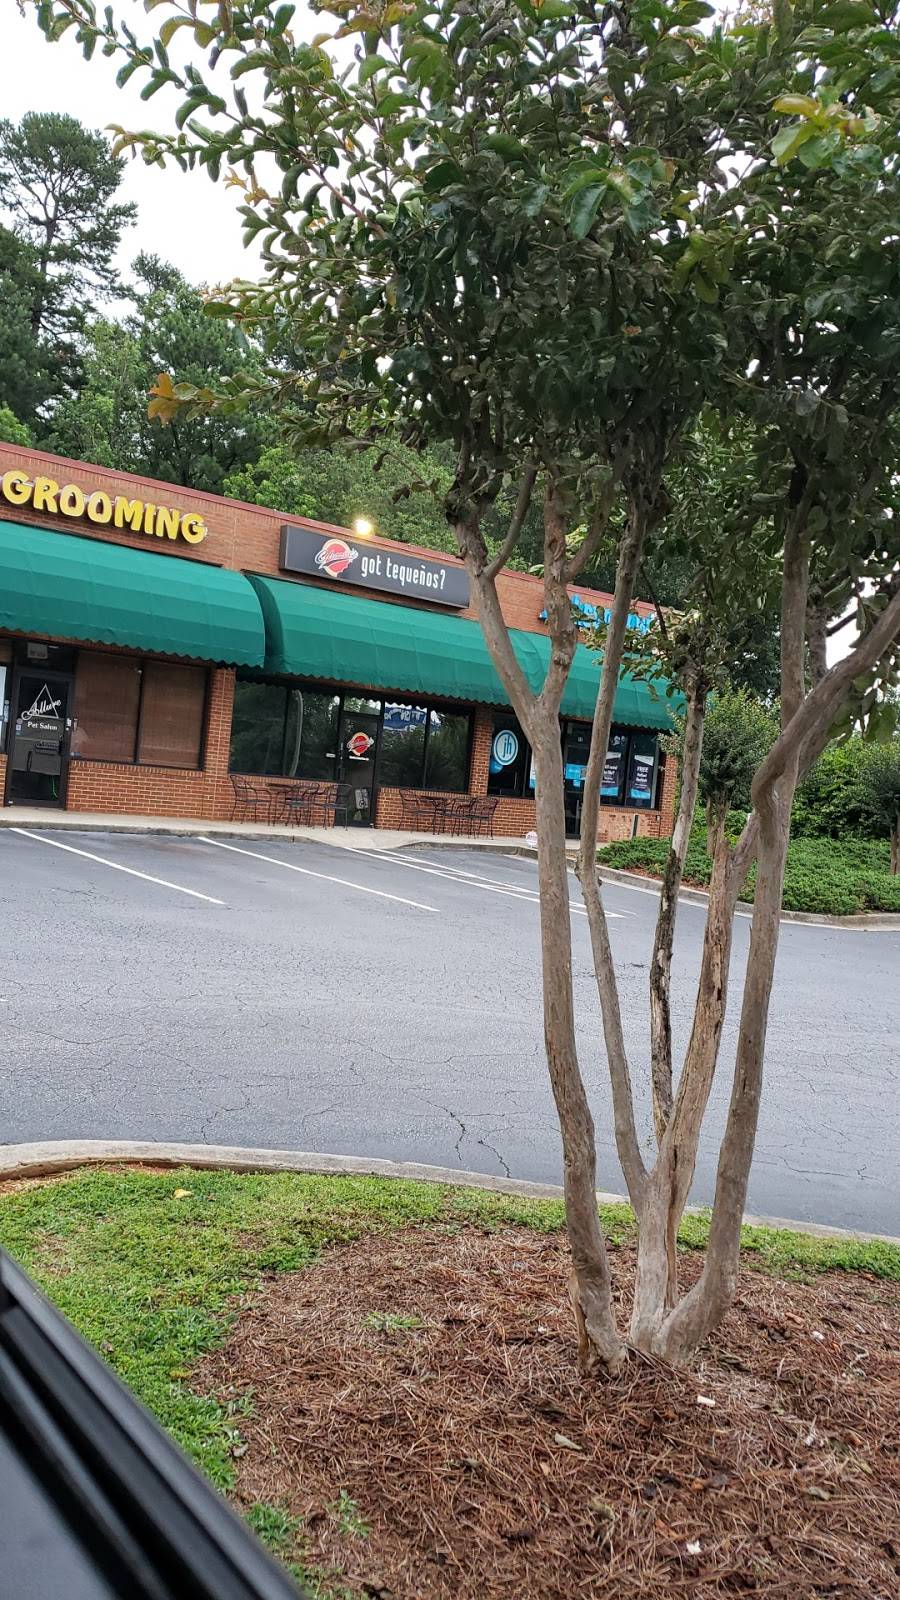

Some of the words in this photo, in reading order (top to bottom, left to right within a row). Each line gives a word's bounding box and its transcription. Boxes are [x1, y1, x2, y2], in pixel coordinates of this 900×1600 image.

[2, 470, 207, 544] GROOMING
[361, 555, 382, 577] got
[386, 557, 446, 590] tequeños?
[21, 699, 62, 721] Allure
[27, 721, 38, 729] Pet
[39, 722, 58, 731] Salon
[502, 735, 512, 757] jh
